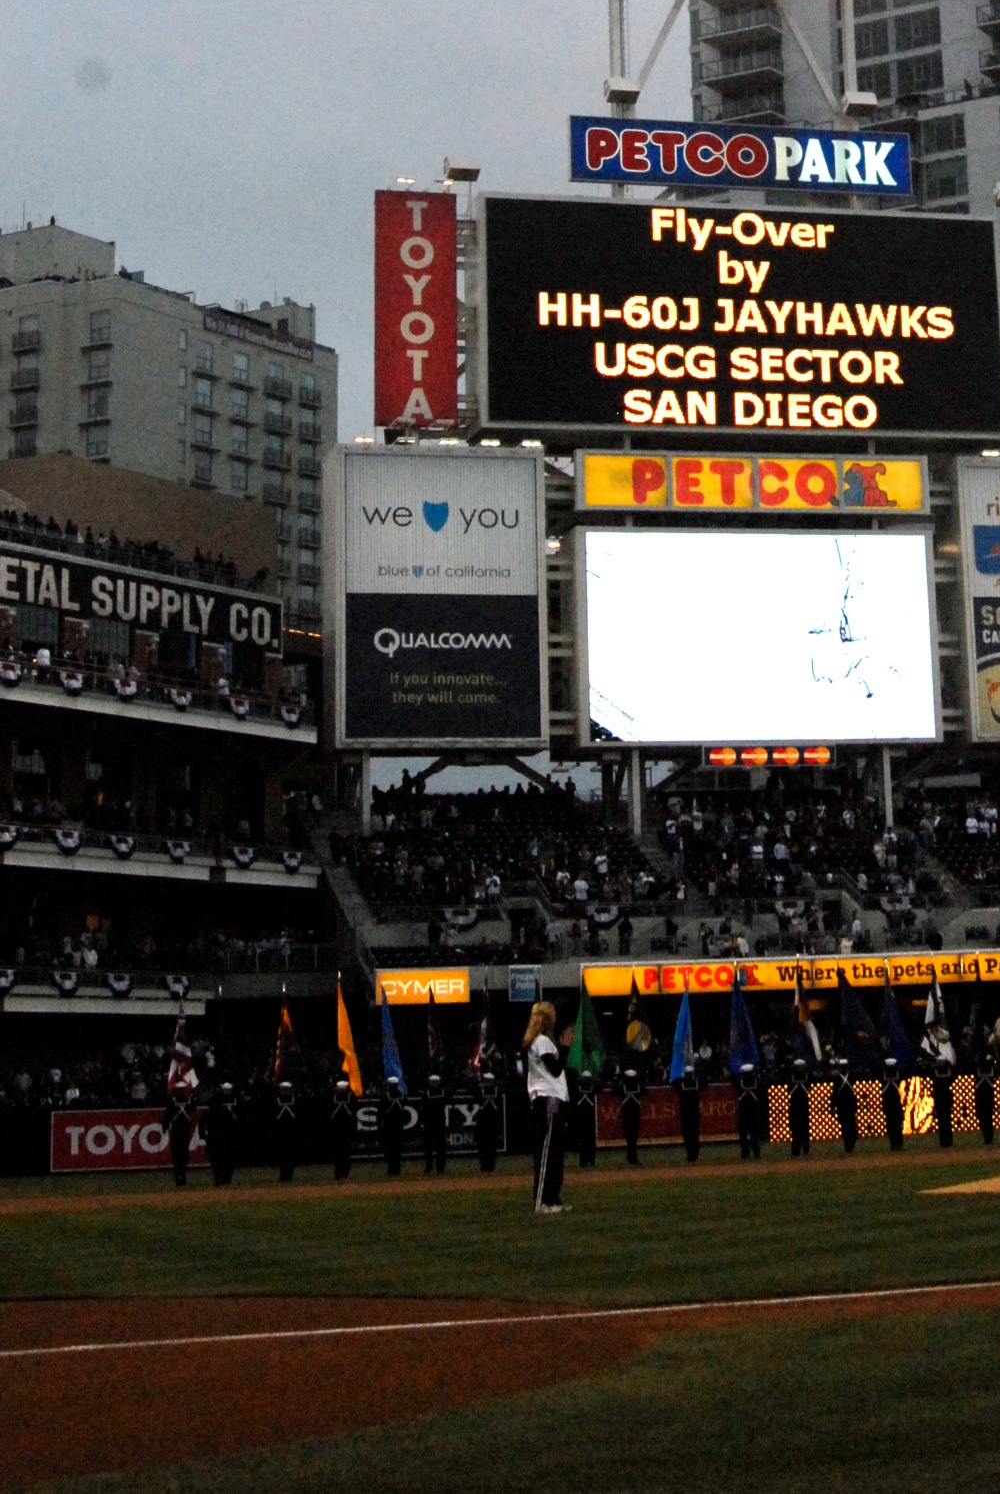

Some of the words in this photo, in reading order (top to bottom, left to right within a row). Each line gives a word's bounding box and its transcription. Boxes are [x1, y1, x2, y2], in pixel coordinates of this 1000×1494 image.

[585, 127, 769, 178] PETCO
[773, 136, 898, 186] PARK
[651, 208, 834, 251] Fly-Over
[718, 250, 770, 293] by
[400, 200, 435, 421] TOYOTA
[538, 292, 700, 331] HH-60J
[714, 300, 954, 339] JAYHAWKS
[595, 342, 716, 379] USCG
[730, 347, 904, 385] SECTOR
[623, 389, 717, 426] SAN
[734, 392, 878, 430] DIEGO
[631, 458, 837, 507] PETCO
[362, 506, 413, 527] we
[460, 508, 519, 534] you
[378, 565, 409, 577] blue
[426, 565, 440, 578] of
[445, 565, 511, 578] california
[90, 575, 215, 635] SUPPLY
[229, 602, 280, 648] CO.
[374, 628, 512, 658] QUALCOMM
[389, 672, 399, 684] If
[403, 674, 428, 688] you
[392, 692, 422, 704] they
[427, 692, 452, 703] will
[458, 693, 501, 704] come.
[382, 978, 464, 995] CYMER
[643, 965, 734, 990] PETCO
[776, 961, 847, 983] Where
[851, 964, 884, 979] the
[892, 962, 935, 982] pets
[941, 958, 978, 976] and
[65, 1121, 207, 1156] TOYOA
